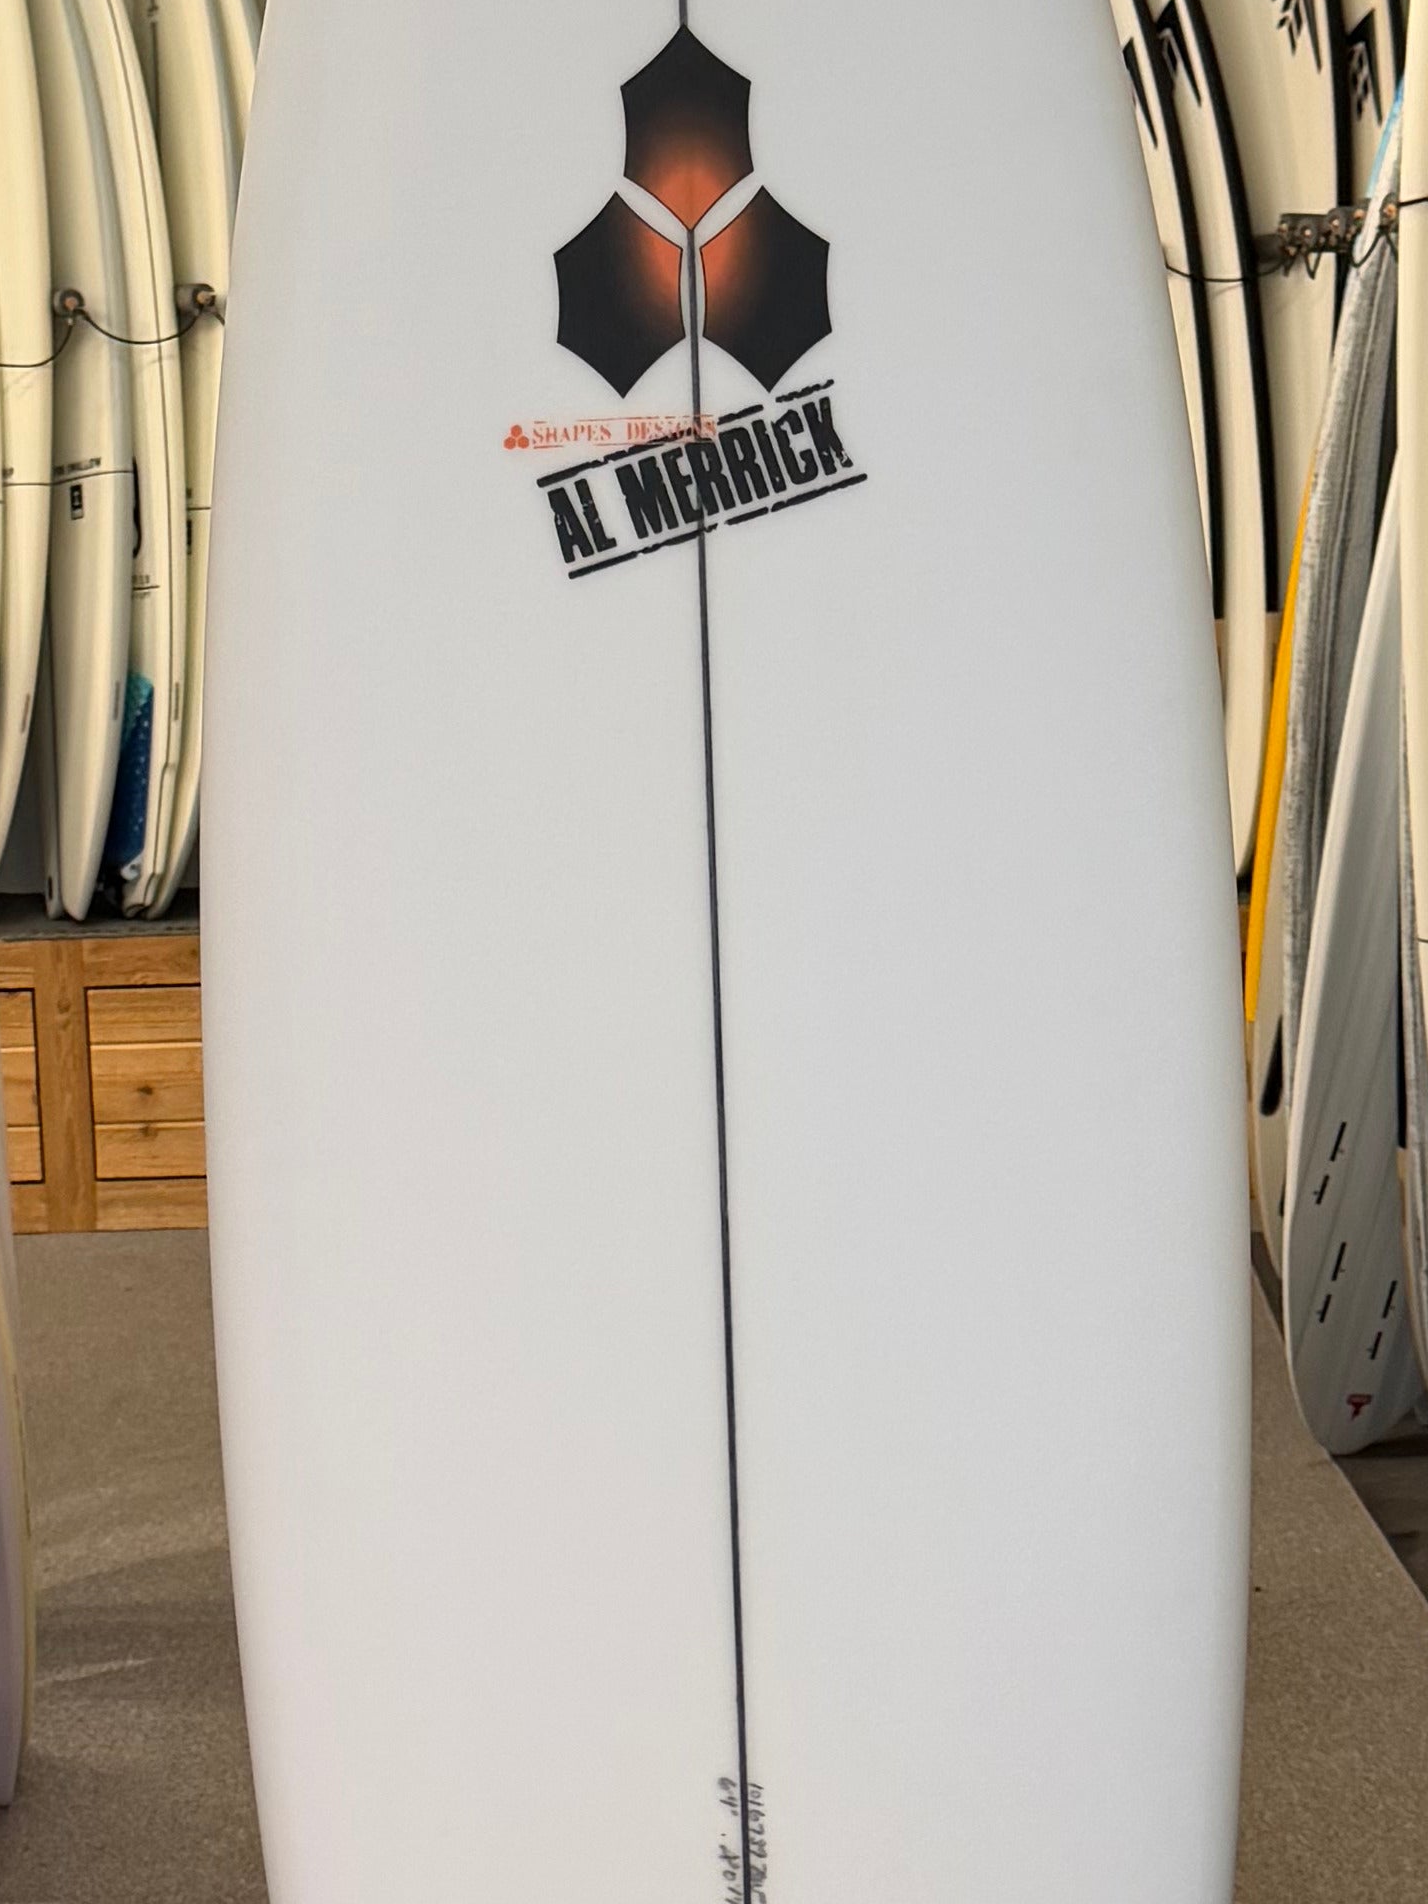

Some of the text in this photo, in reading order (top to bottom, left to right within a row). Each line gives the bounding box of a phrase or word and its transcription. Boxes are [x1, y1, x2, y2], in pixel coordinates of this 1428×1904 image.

[532, 420, 613, 446] SHAPES
[546, 396, 855, 564] AL MERRICK
